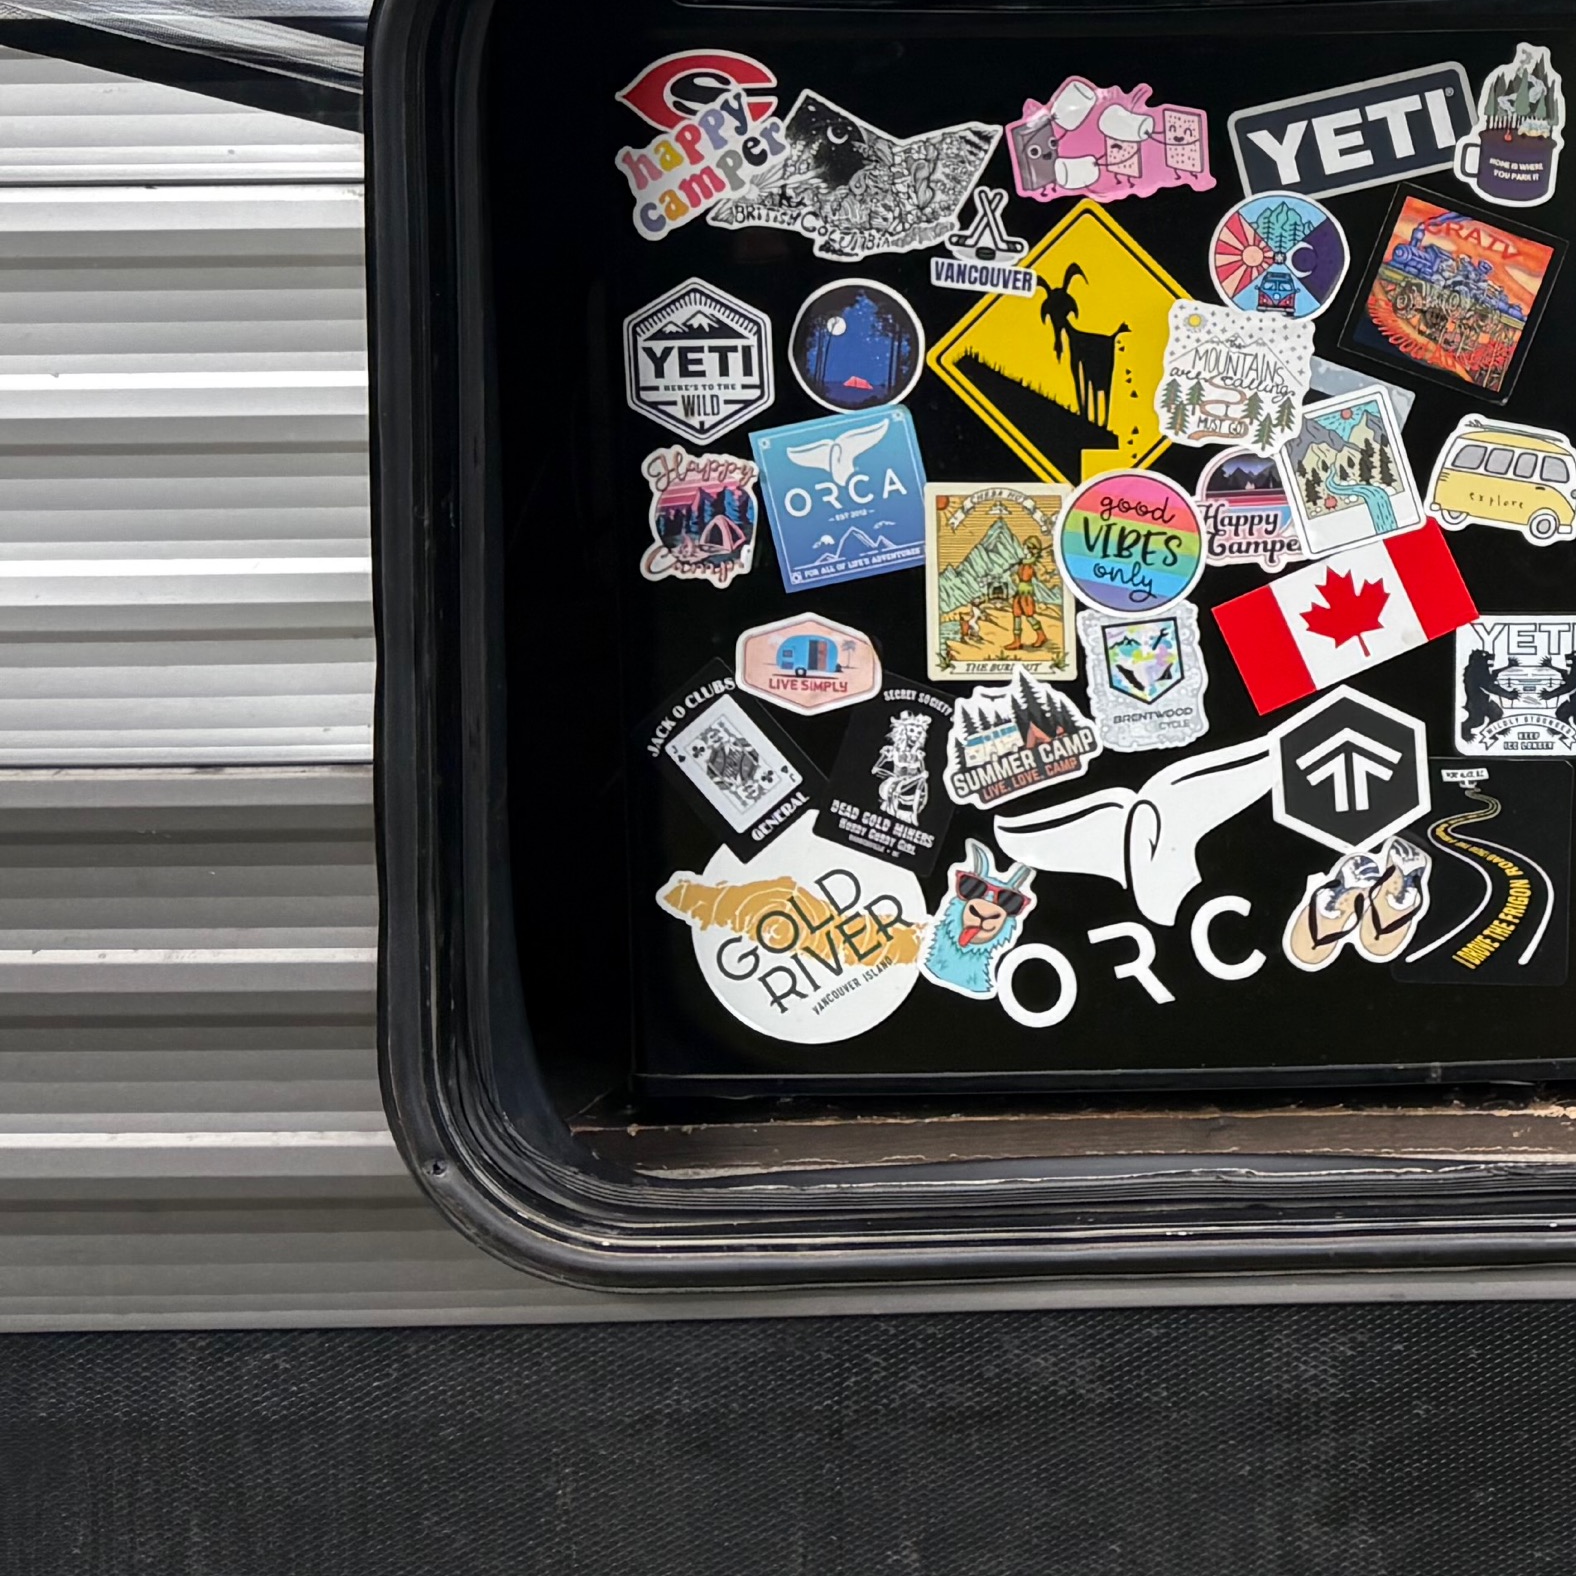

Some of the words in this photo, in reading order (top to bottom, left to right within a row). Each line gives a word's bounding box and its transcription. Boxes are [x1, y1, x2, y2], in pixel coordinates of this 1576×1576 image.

[622, 92, 750, 190] happy
[1246, 88, 1457, 186] YETI
[640, 122, 786, 232] camper
[935, 262, 1033, 292] VANCOUVER
[642, 345, 754, 379] YETI
[1192, 347, 1284, 385] MOUNTAINS
[717, 383, 737, 391] THE
[1221, 376, 1296, 404] calling
[681, 394, 721, 417] WILD
[647, 451, 756, 492] Happy
[784, 468, 907, 517] ORCA
[1470, 492, 1523, 509] explore
[1100, 496, 1175, 524] good
[1197, 503, 1278, 536] Happy
[1083, 516, 1182, 566] VIBES
[1207, 531, 1303, 565] Campe
[804, 569, 820, 578] FOR
[821, 565, 836, 575] ALL
[836, 562, 846, 571] OF
[871, 548, 921, 565] ADVENTURES
[1093, 561, 1157, 603] only
[965, 663, 988, 672] THE
[769, 678, 800, 690] LIVE
[801, 679, 848, 694] SIMPLY
[884, 689, 917, 702] SECRET
[918, 692, 953, 717] SOCIETY
[647, 717, 676, 757] JACK
[672, 705, 686, 719] O
[685, 677, 736, 708] CLUBS
[1113, 707, 1193, 724] BRENTWOOD
[1159, 720, 1190, 730] CYCLE
[953, 750, 1036, 796] SUMMER
[1038, 728, 1093, 763] CAMP
[982, 781, 1010, 800] LIVE.
[1013, 770, 1045, 786] LOVE.
[1045, 757, 1077, 774] CAMP
[751, 791, 810, 841] GENERAL
[830, 799, 860, 820] DEAD
[862, 811, 891, 832] GOLD
[892, 822, 936, 848] MINERS
[1486, 854, 1524, 876] ROAD
[1499, 879, 1532, 924] FRIGON
[716, 869, 862, 981] GOLD
[1483, 920, 1516, 941] THE
[758, 894, 918, 1014] RIVER
[998, 895, 1267, 1028] ORC
[1452, 955, 1476, 970] I
[1456, 935, 1500, 966] DROVE
[812, 977, 862, 1016] VANCOUVER
[862, 955, 893, 982] ISLAND
